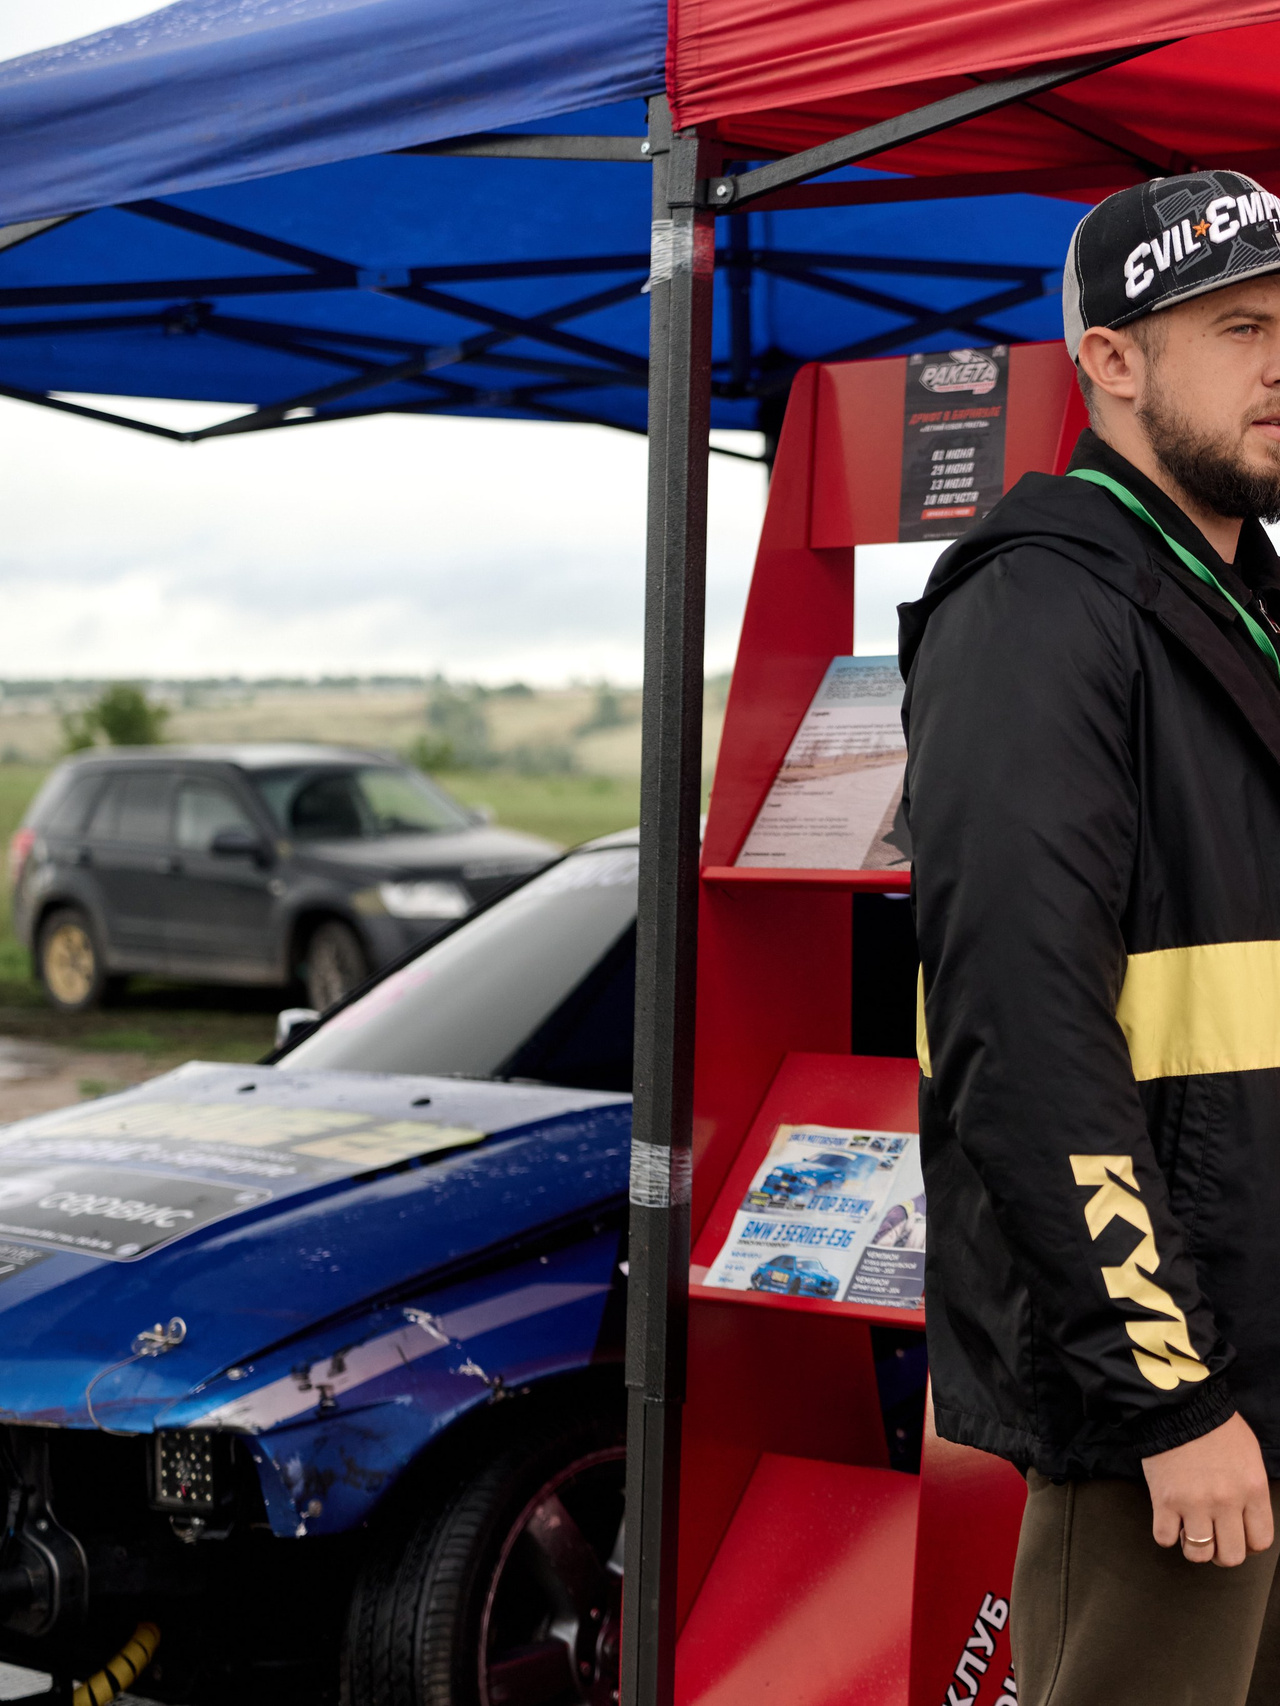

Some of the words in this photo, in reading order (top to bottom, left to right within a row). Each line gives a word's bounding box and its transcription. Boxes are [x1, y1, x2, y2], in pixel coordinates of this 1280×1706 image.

[1124, 219, 1201, 299] EVIL
[921, 362, 995, 385] РАКЕТА
[944, 447, 975, 460] ИЮНЯ
[930, 464, 945, 476] 29
[944, 462, 975, 475] ИЮНЯ
[929, 479, 944, 491] 13
[943, 476, 974, 489] ИЮЛЯ
[937, 491, 979, 504] АВГУСТА
[741, 1220, 778, 1240] BMW
[773, 1223, 786, 1241] 3
[1069, 1154, 1211, 1391] KYB
